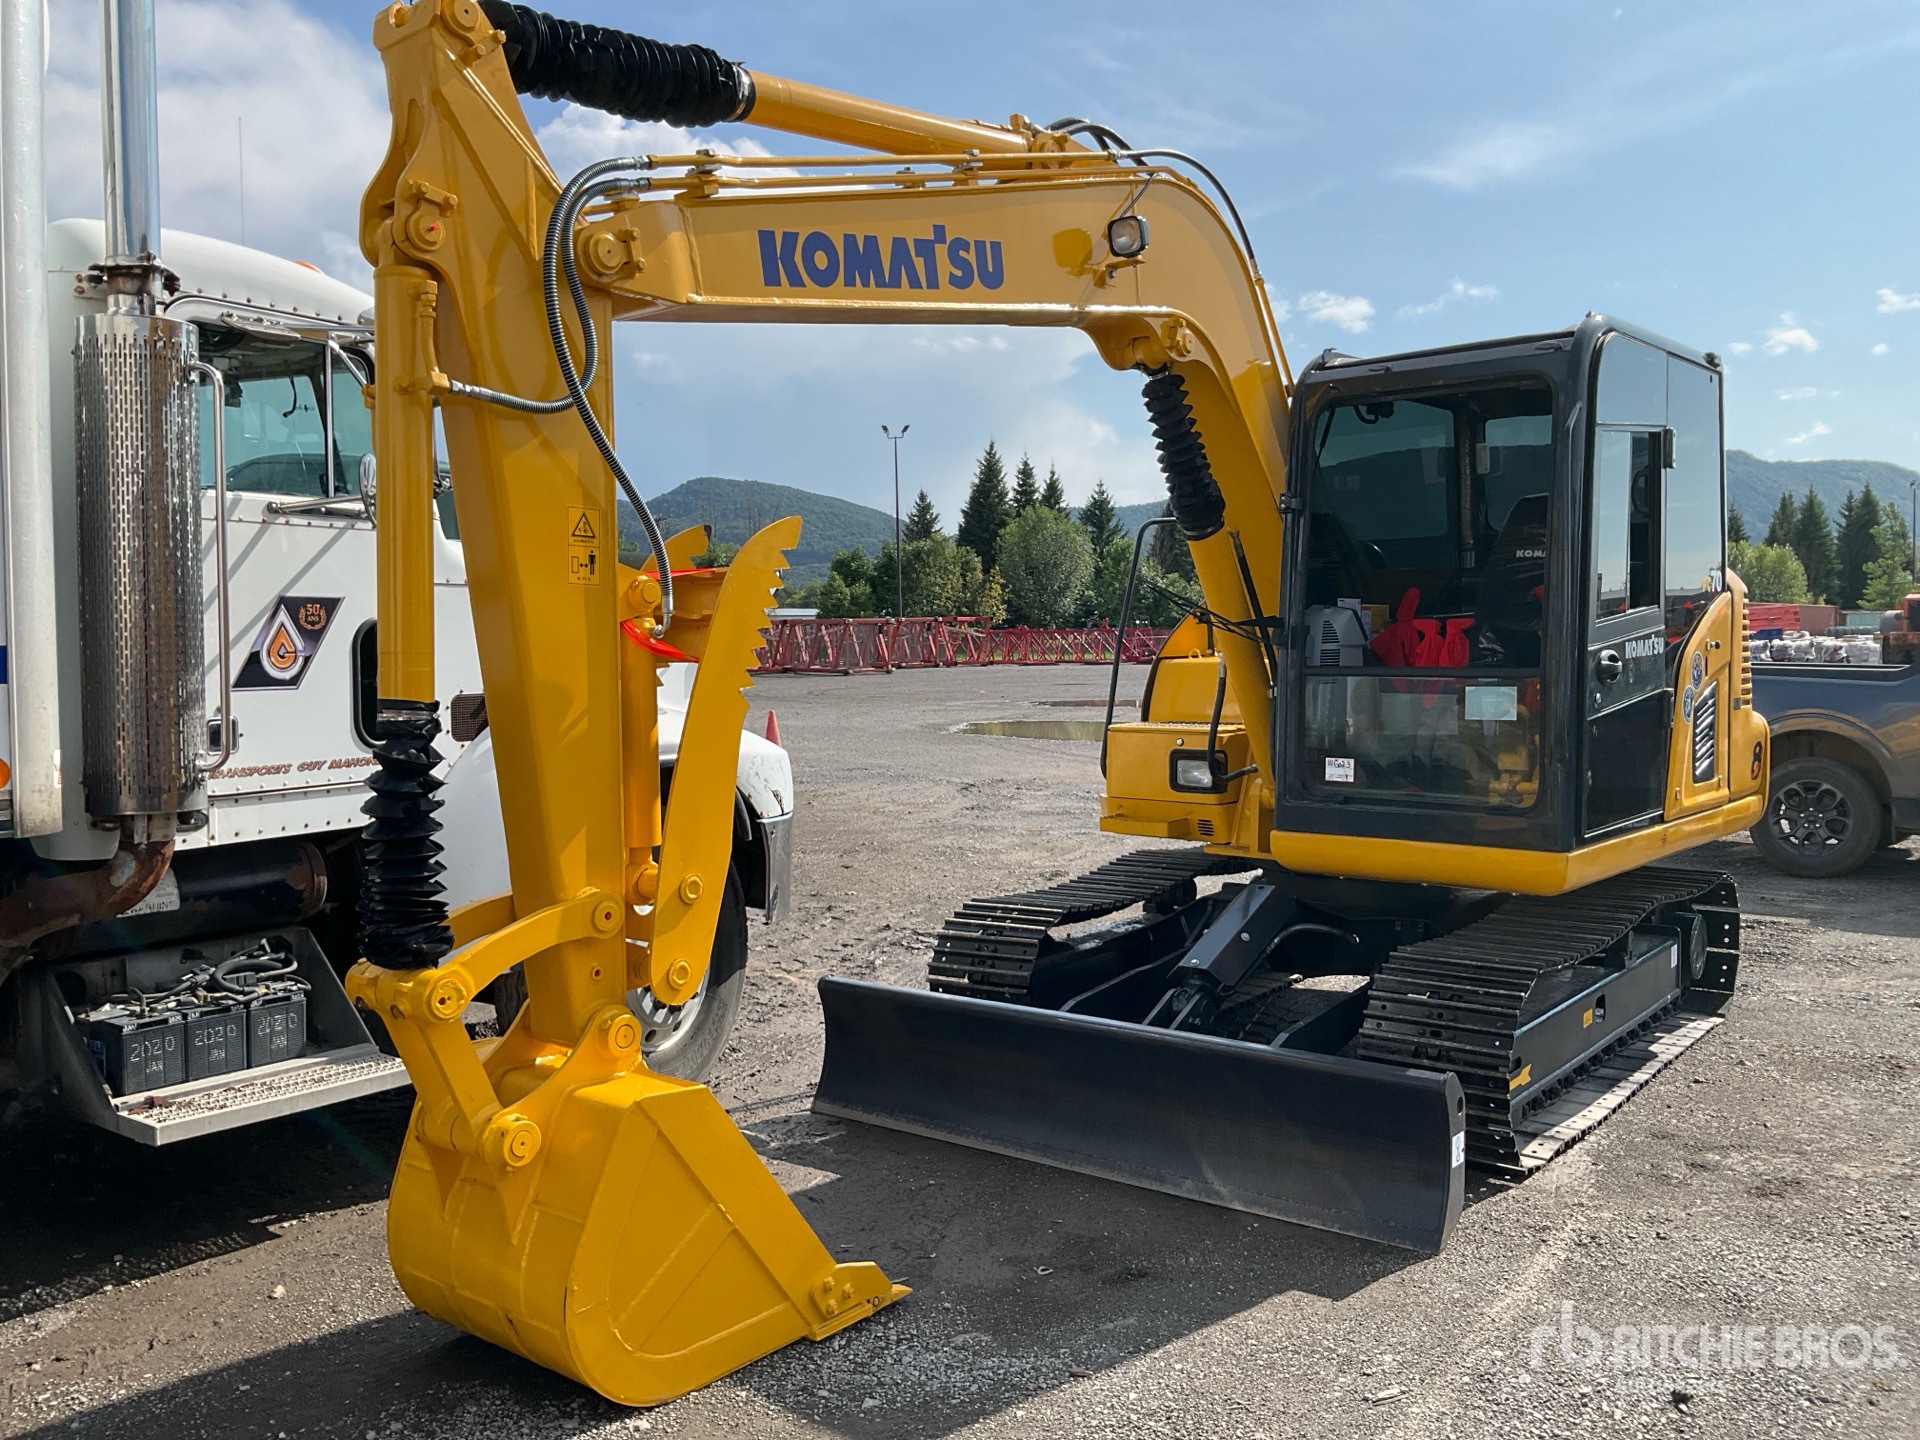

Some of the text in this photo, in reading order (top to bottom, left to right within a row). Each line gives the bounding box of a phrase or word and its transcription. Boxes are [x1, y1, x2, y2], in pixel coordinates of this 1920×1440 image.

[757, 224, 1005, 290] KOMATSU
[306, 604, 320, 615] 50
[1625, 634, 1664, 659] KOMATSU
[297, 759, 327, 772] GUY
[195, 1024, 236, 1046] 2020
[130, 1036, 175, 1061] 2020
